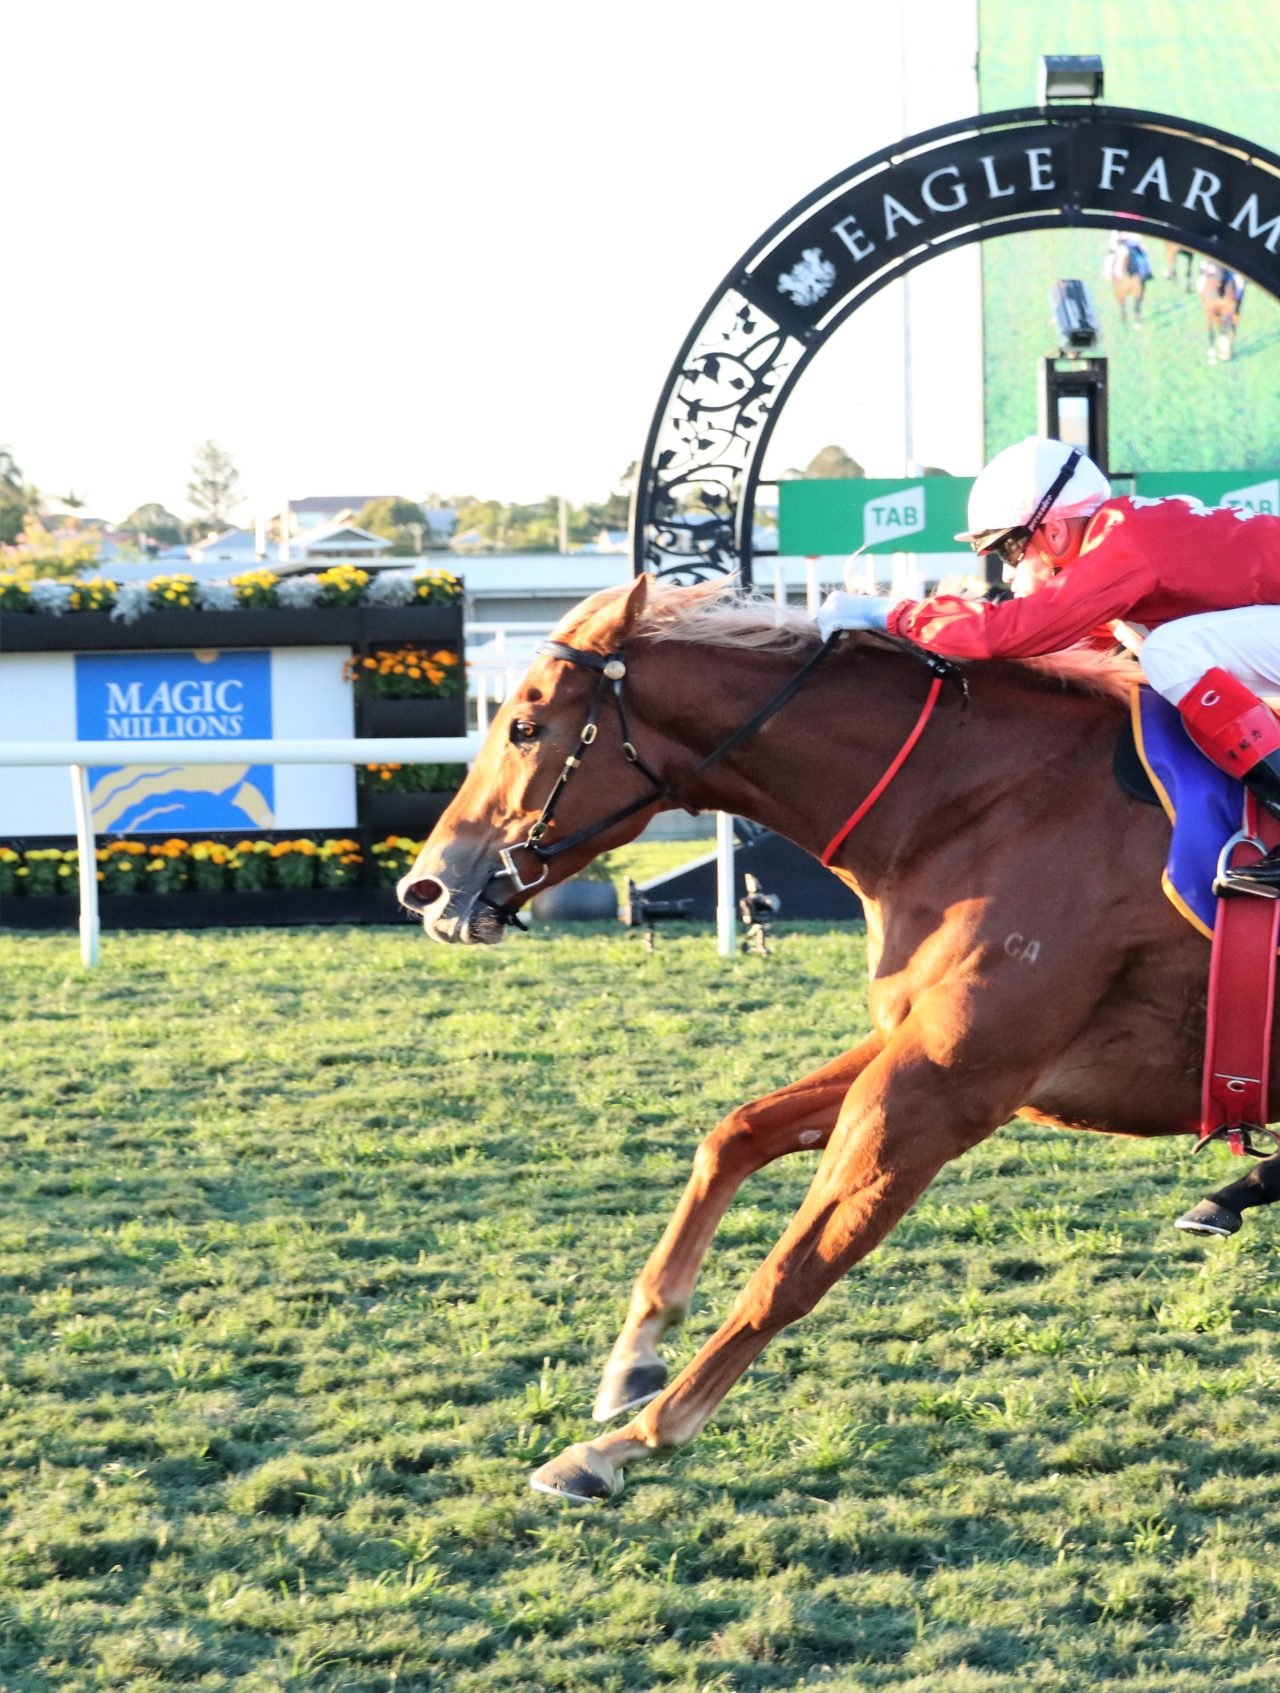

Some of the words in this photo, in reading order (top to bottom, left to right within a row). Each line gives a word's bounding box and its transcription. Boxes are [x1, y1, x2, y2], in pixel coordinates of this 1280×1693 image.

[831, 147, 1056, 262] EAGLE
[871, 506, 918, 527] TAB
[105, 679, 244, 715] MAGIC
[106, 714, 244, 739] MILLIONS
